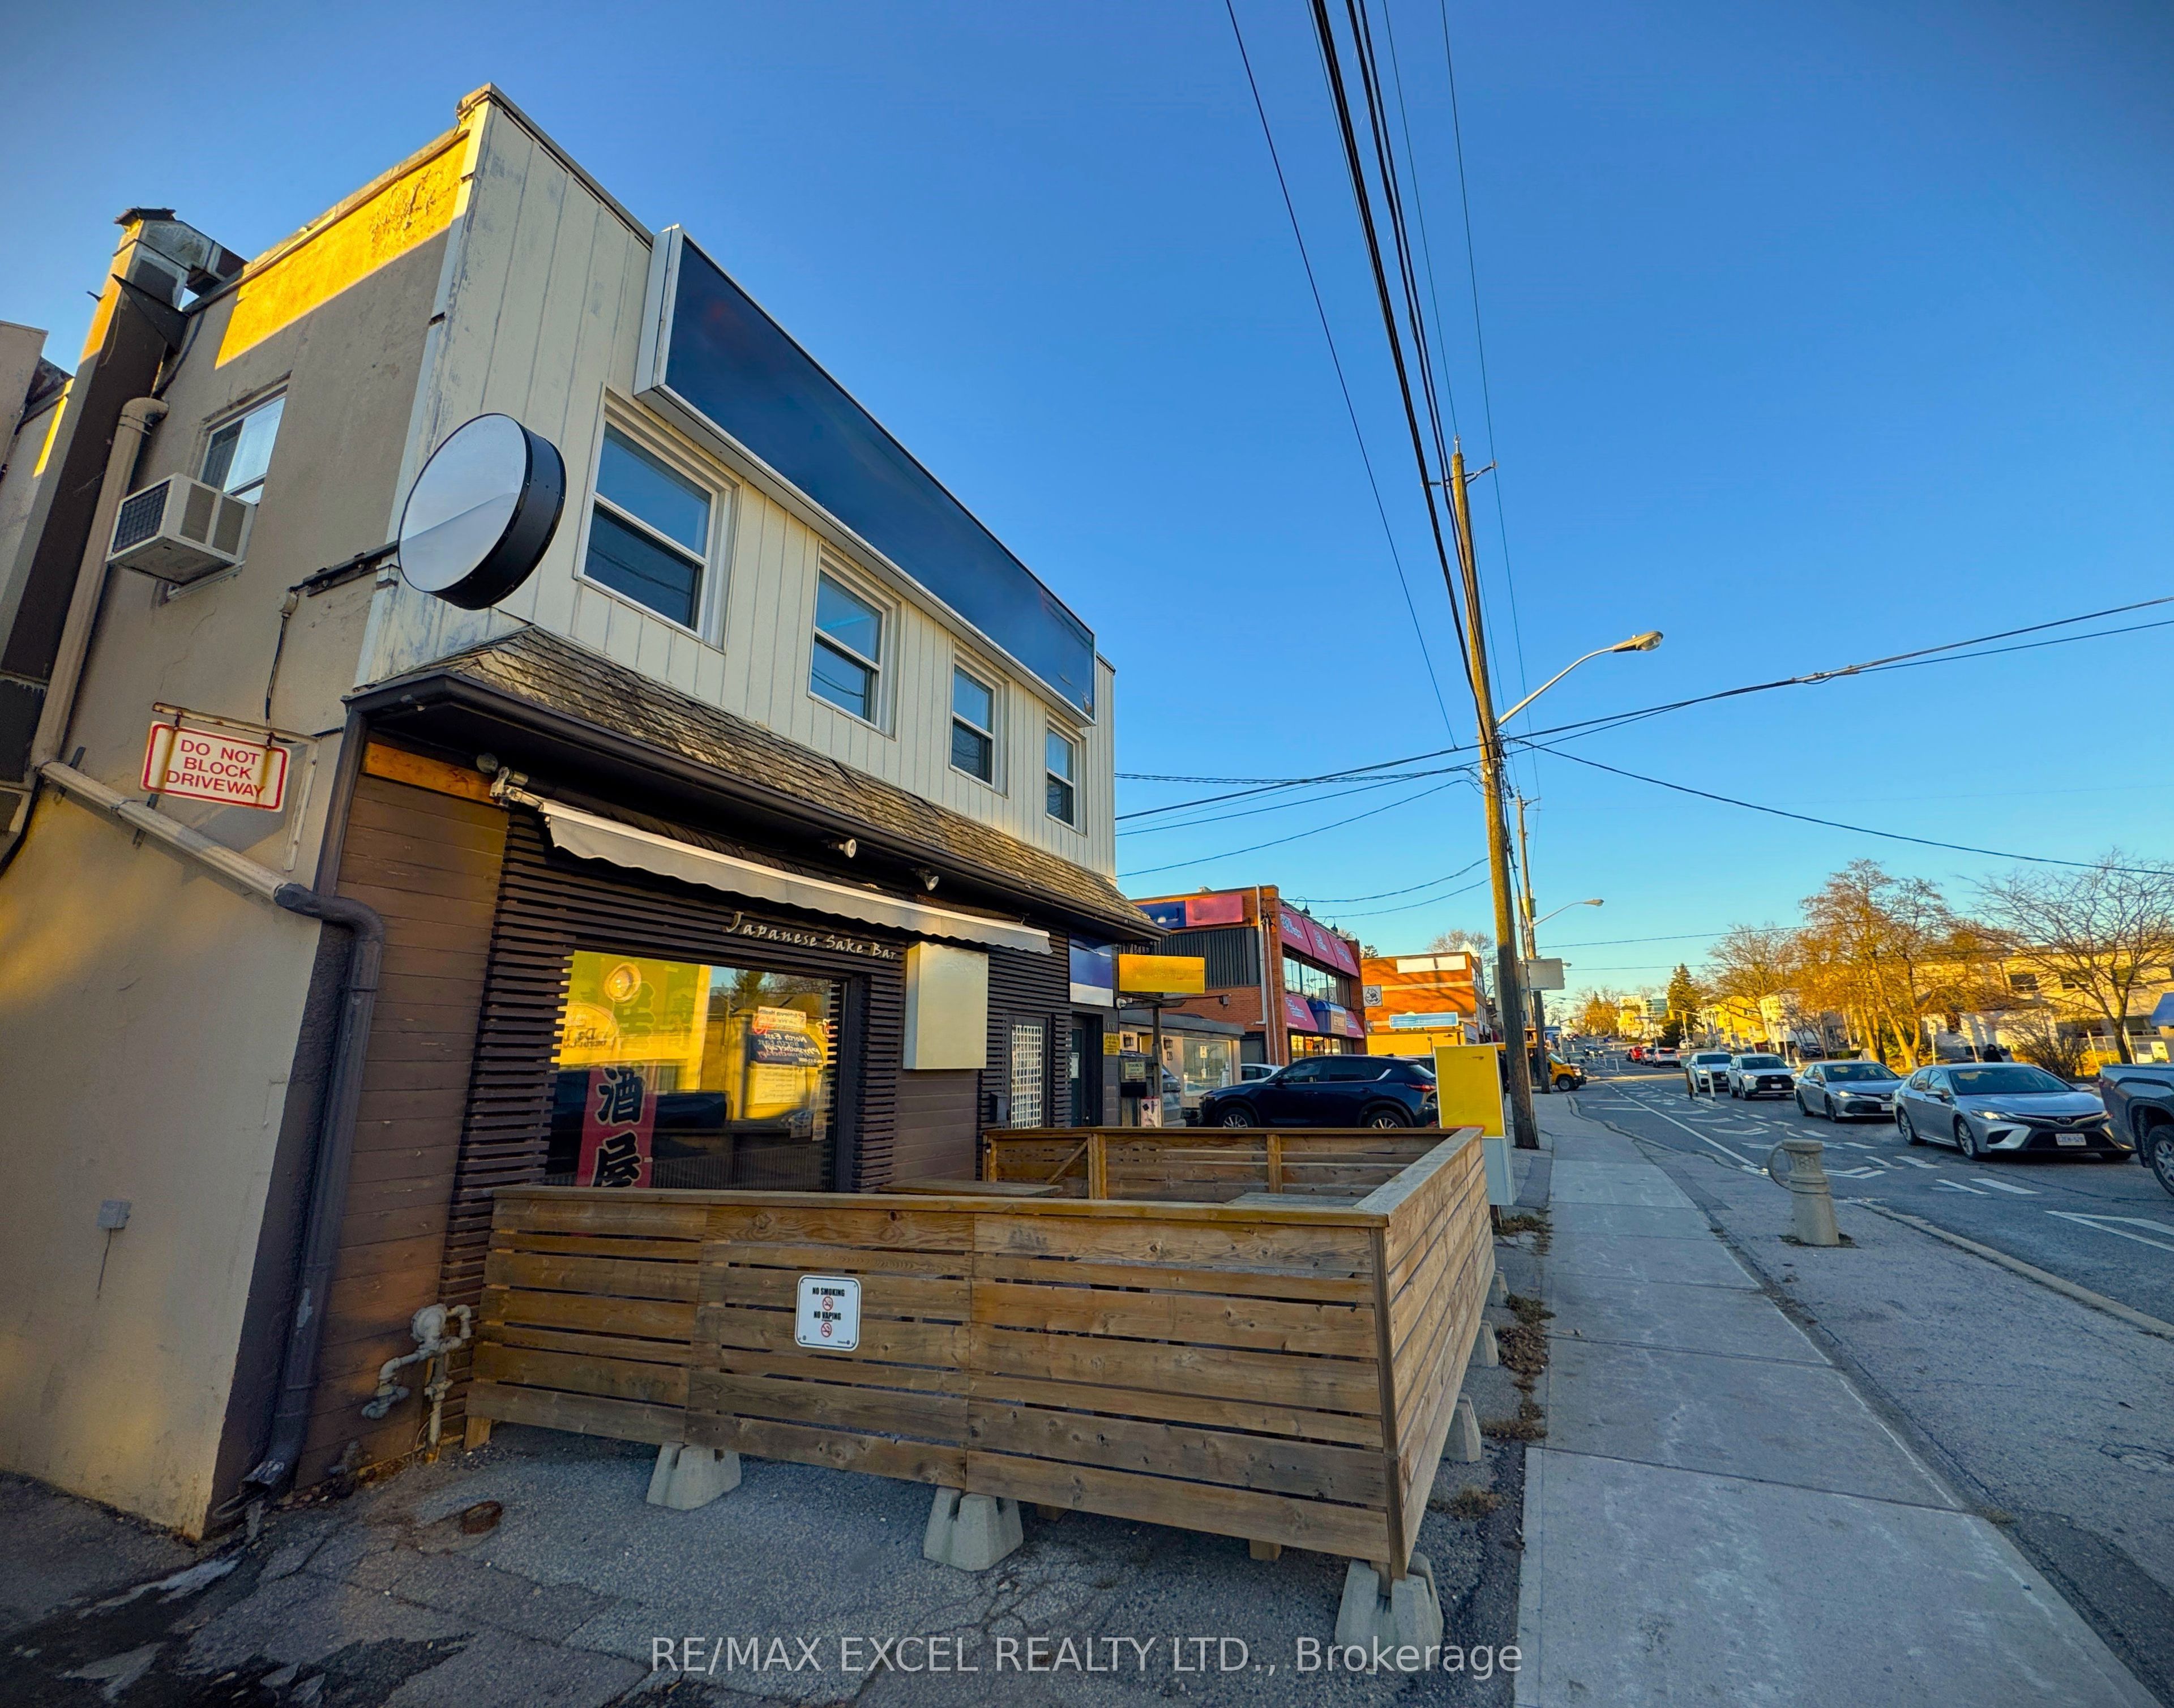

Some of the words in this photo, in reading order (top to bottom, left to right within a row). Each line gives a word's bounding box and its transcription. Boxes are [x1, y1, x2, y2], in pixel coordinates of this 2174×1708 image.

[181, 739, 211, 756] DO
[220, 747, 260, 765] NOT
[183, 756, 252, 780] BLOCK
[166, 770, 265, 798] DRIVEWAY
[722, 911, 818, 947] Japanese
[824, 934, 864, 954] Sake
[870, 941, 897, 960] Bar
[820, 1288, 845, 1296] SMOKING
[821, 1312, 841, 1320] VAPING
